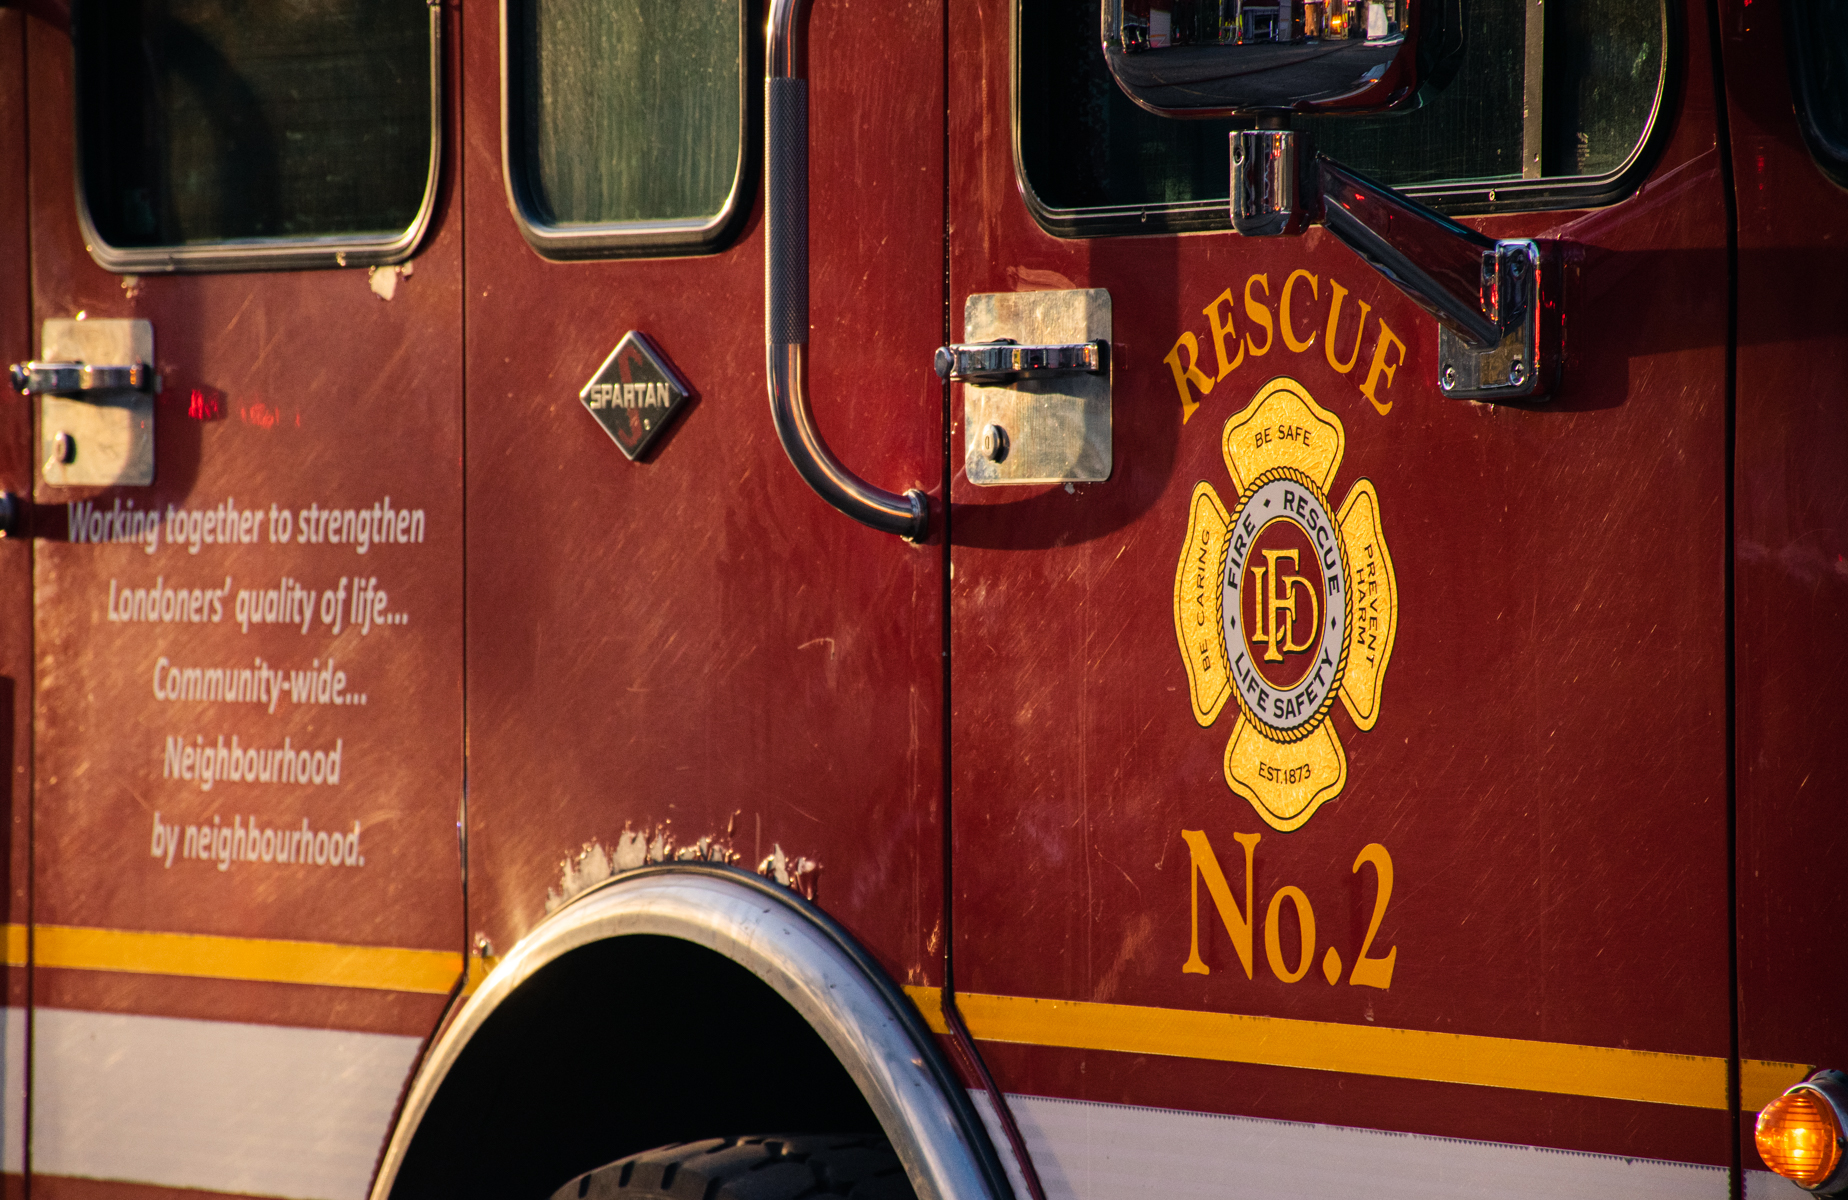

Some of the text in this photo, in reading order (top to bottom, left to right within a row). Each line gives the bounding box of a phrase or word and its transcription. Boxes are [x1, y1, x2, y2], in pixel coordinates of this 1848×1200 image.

[1163, 268, 1407, 425] RESCUE
[590, 382, 670, 409] SPARTAN
[1254, 423, 1311, 449] BE SAFE
[67, 496, 425, 555] Working together to strengthen
[1226, 490, 1340, 598] FIRE RESCUE
[235, 578, 316, 634] quality
[320, 577, 347, 635] of
[1196, 528, 1213, 672] BE CARING
[1356, 568, 1368, 646] HARM
[1363, 544, 1377, 669] PREVENT
[1233, 647, 1336, 720] LIFE SAFETY
[163, 735, 343, 791] Neighbourhood
[1258, 761, 1312, 786] EST.1873
[151, 811, 365, 871] by neighbourhood.
[1181, 829, 1398, 989] No.2
